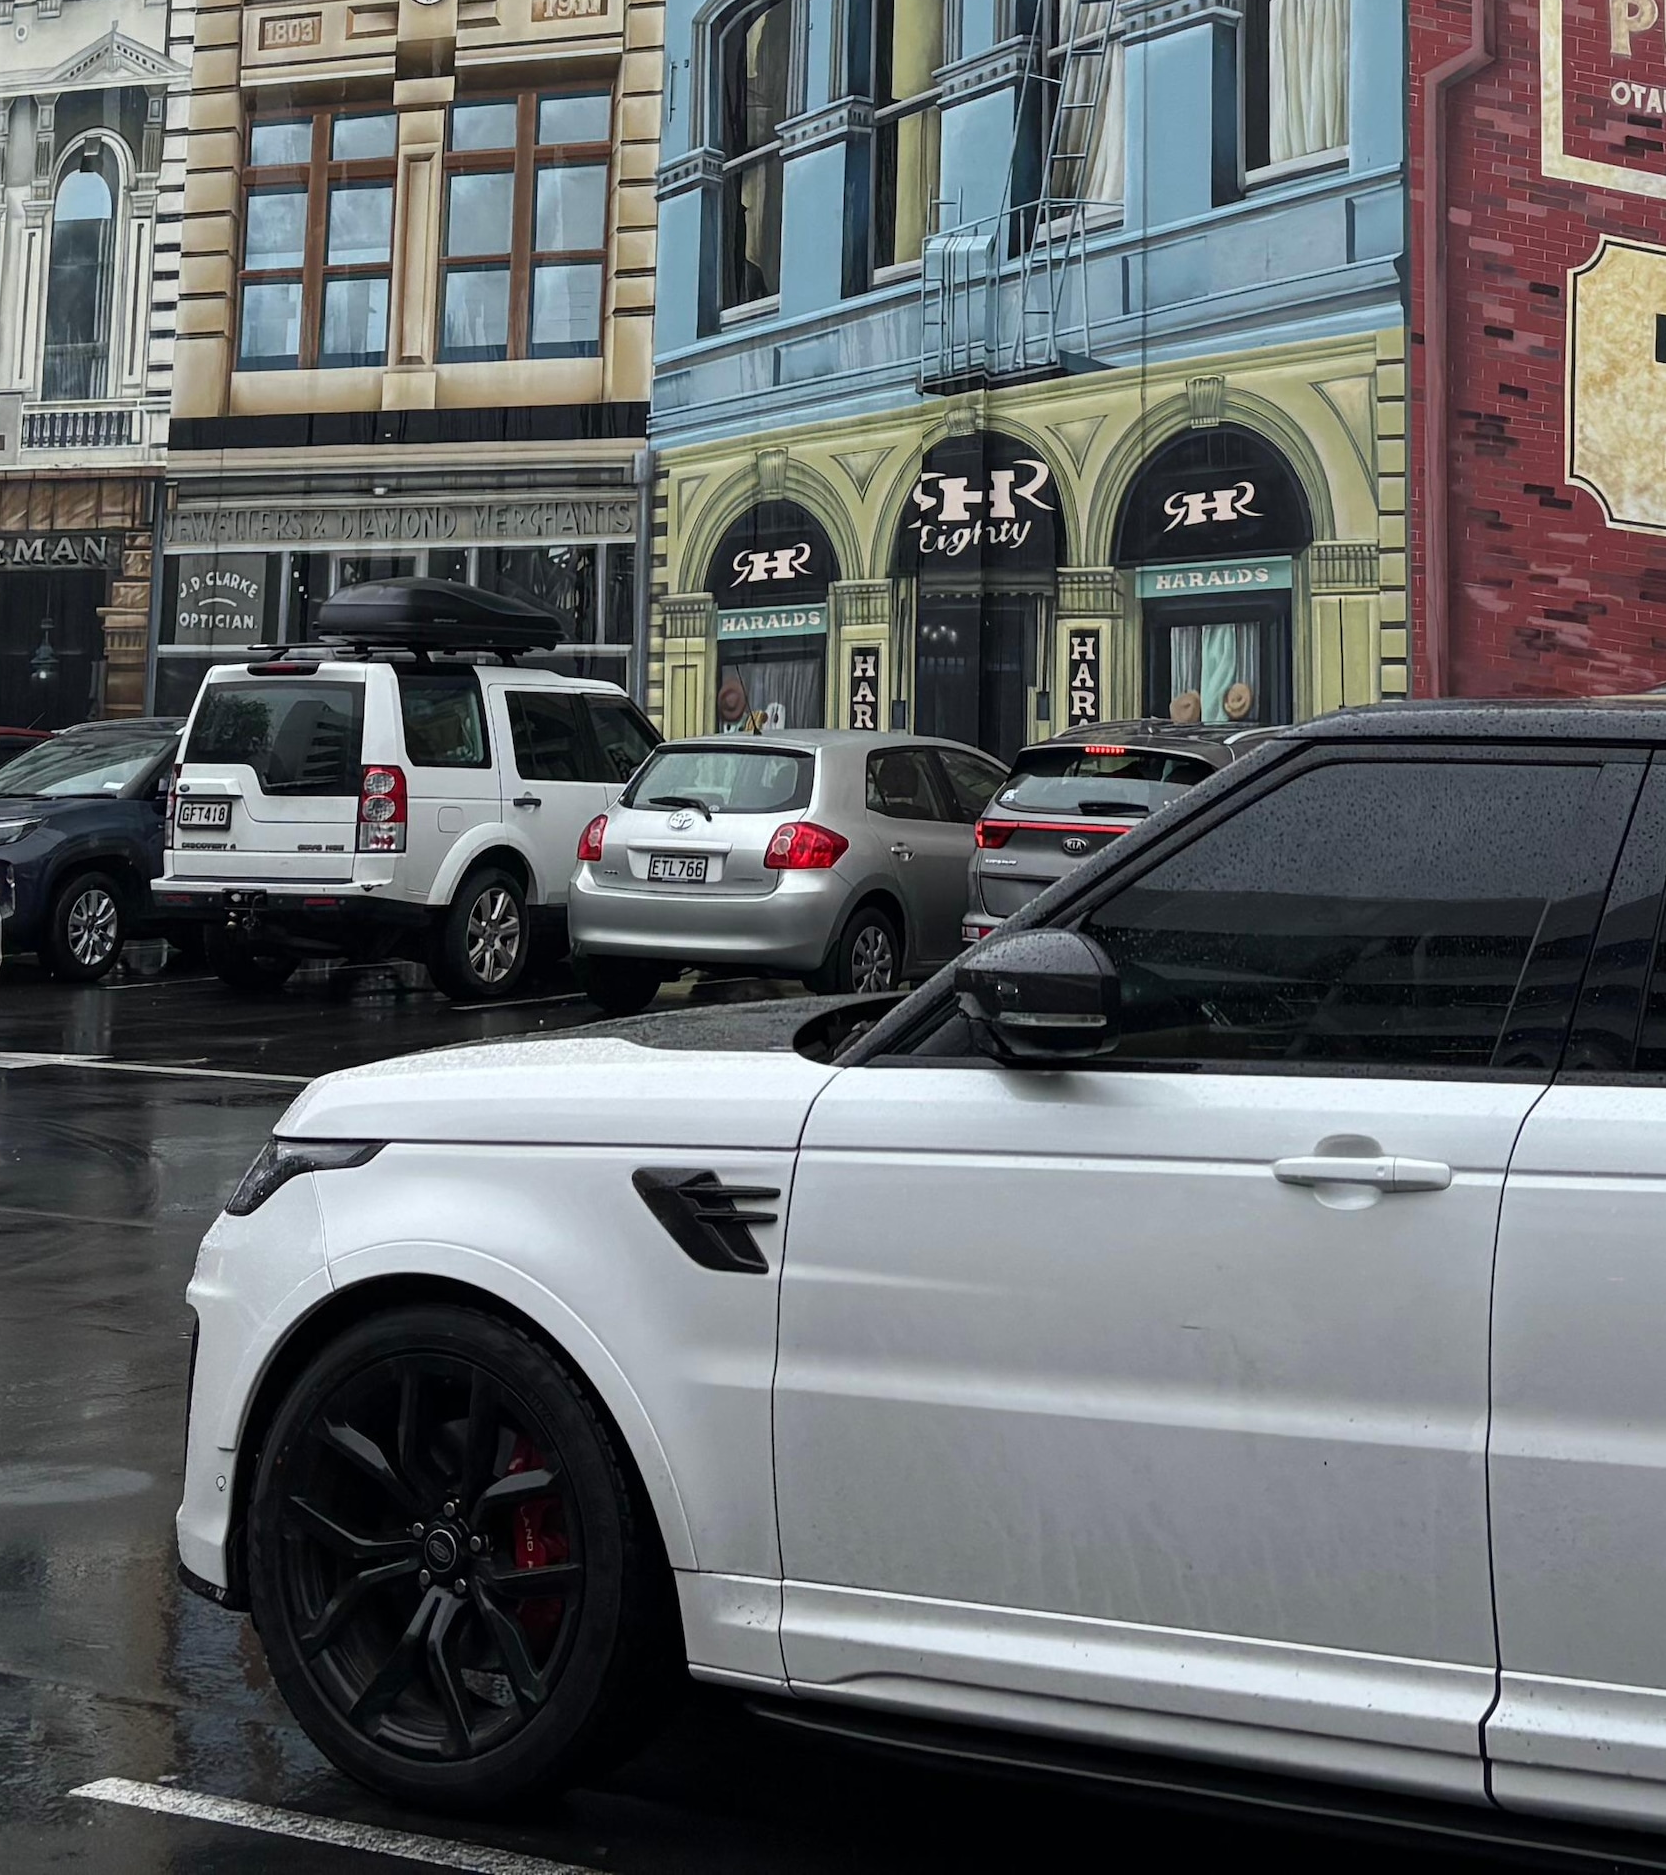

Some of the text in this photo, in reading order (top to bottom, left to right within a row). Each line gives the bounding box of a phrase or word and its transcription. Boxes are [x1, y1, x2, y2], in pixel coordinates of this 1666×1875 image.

[302, 511, 327, 540] &
[339, 506, 458, 540] DIAMOND
[473, 501, 632, 535] MERCHANTS
[1156, 568, 1268, 589] HARALDS
[722, 611, 821, 632] HARALDS
[182, 806, 225, 822] GFT418
[652, 860, 704, 878] ETL766
